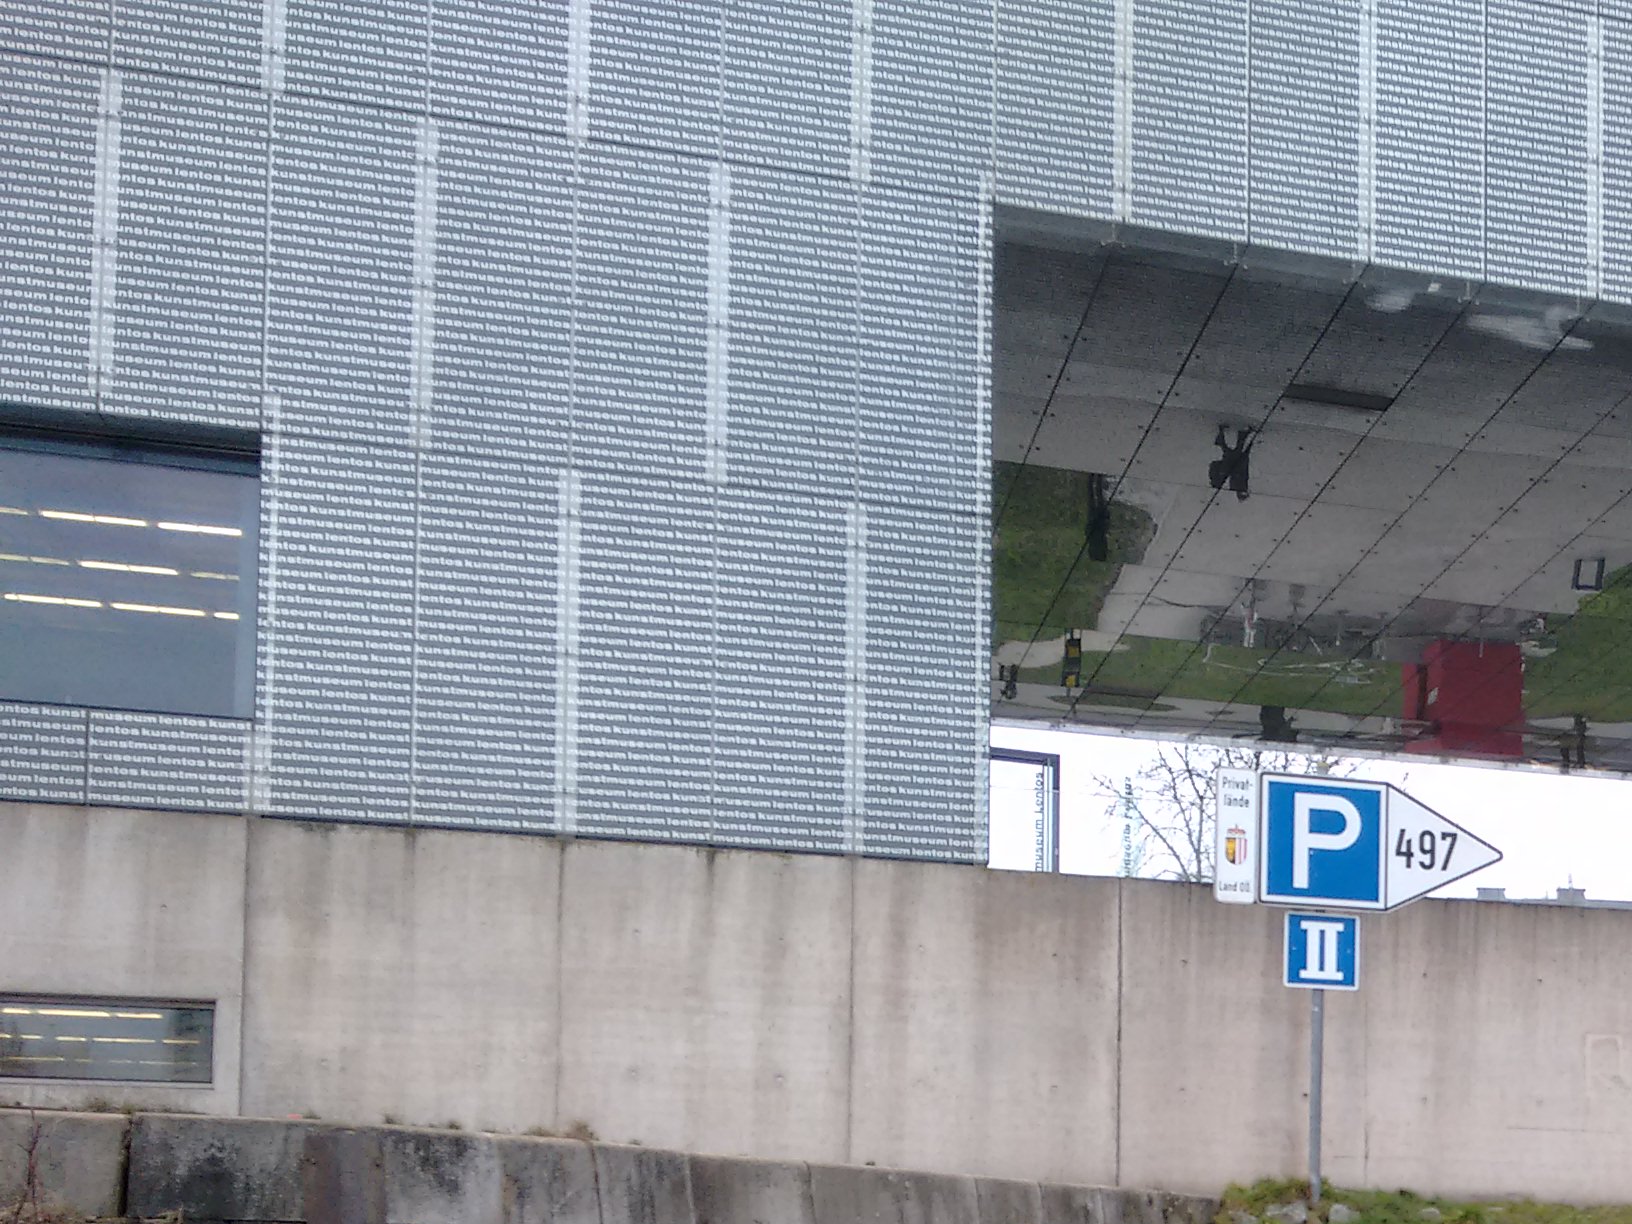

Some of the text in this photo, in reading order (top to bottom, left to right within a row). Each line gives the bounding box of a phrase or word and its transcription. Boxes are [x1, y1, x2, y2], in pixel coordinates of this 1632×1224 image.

[1222, 776, 1253, 790] Privat-
[1292, 792, 1362, 889] P
[1395, 829, 1458, 871] 497
[1299, 920, 1344, 980] II
